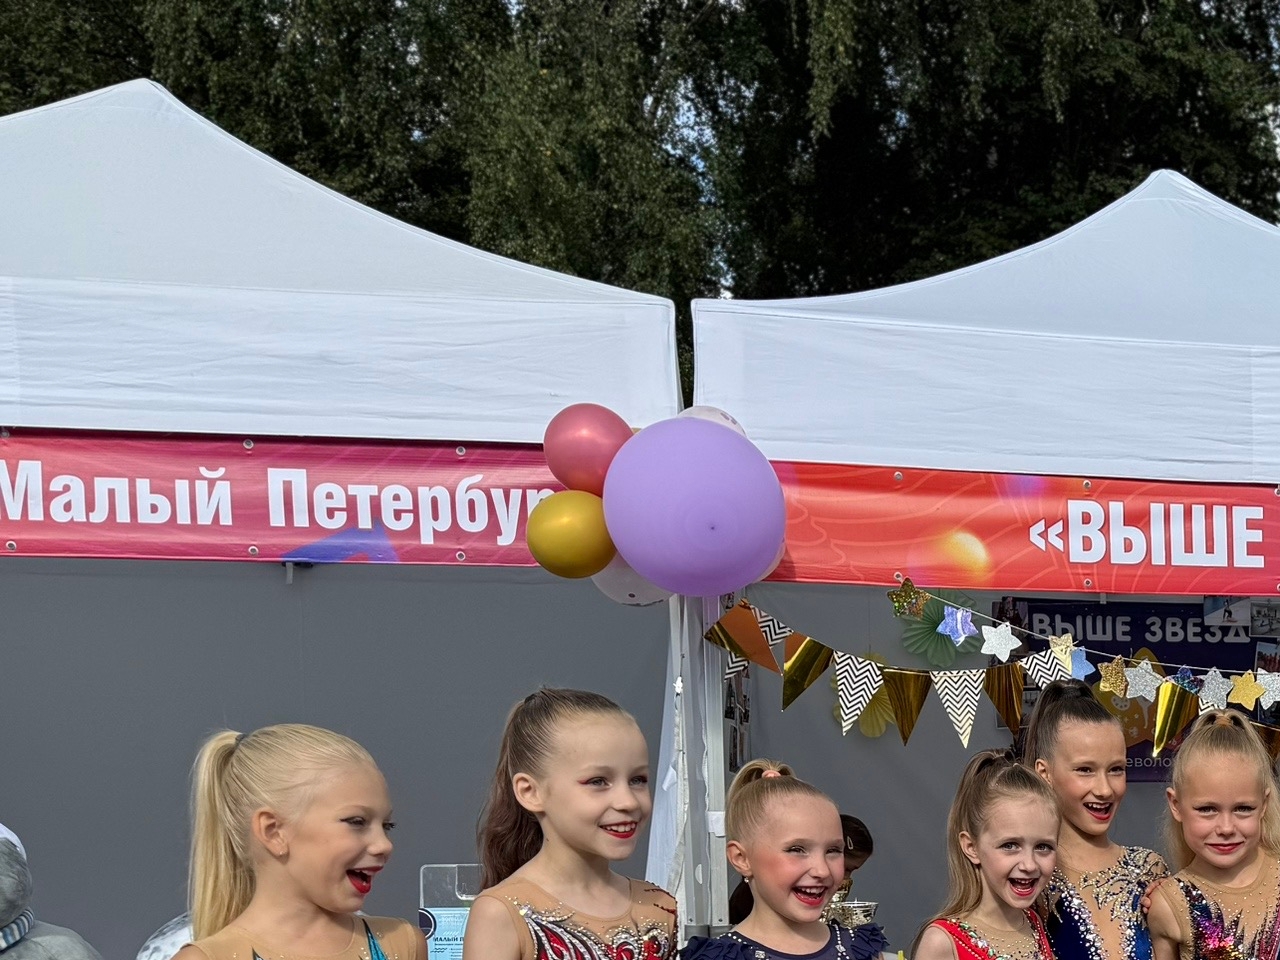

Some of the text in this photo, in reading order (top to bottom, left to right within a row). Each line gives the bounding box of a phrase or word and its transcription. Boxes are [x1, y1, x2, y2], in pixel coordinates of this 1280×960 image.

[0, 459, 233, 526] Малый
[1029, 499, 1265, 568] «ВЫШЕ
[1032, 613, 1132, 642] ВЫШЕ
[1126, 757, 1172, 768] еволо
